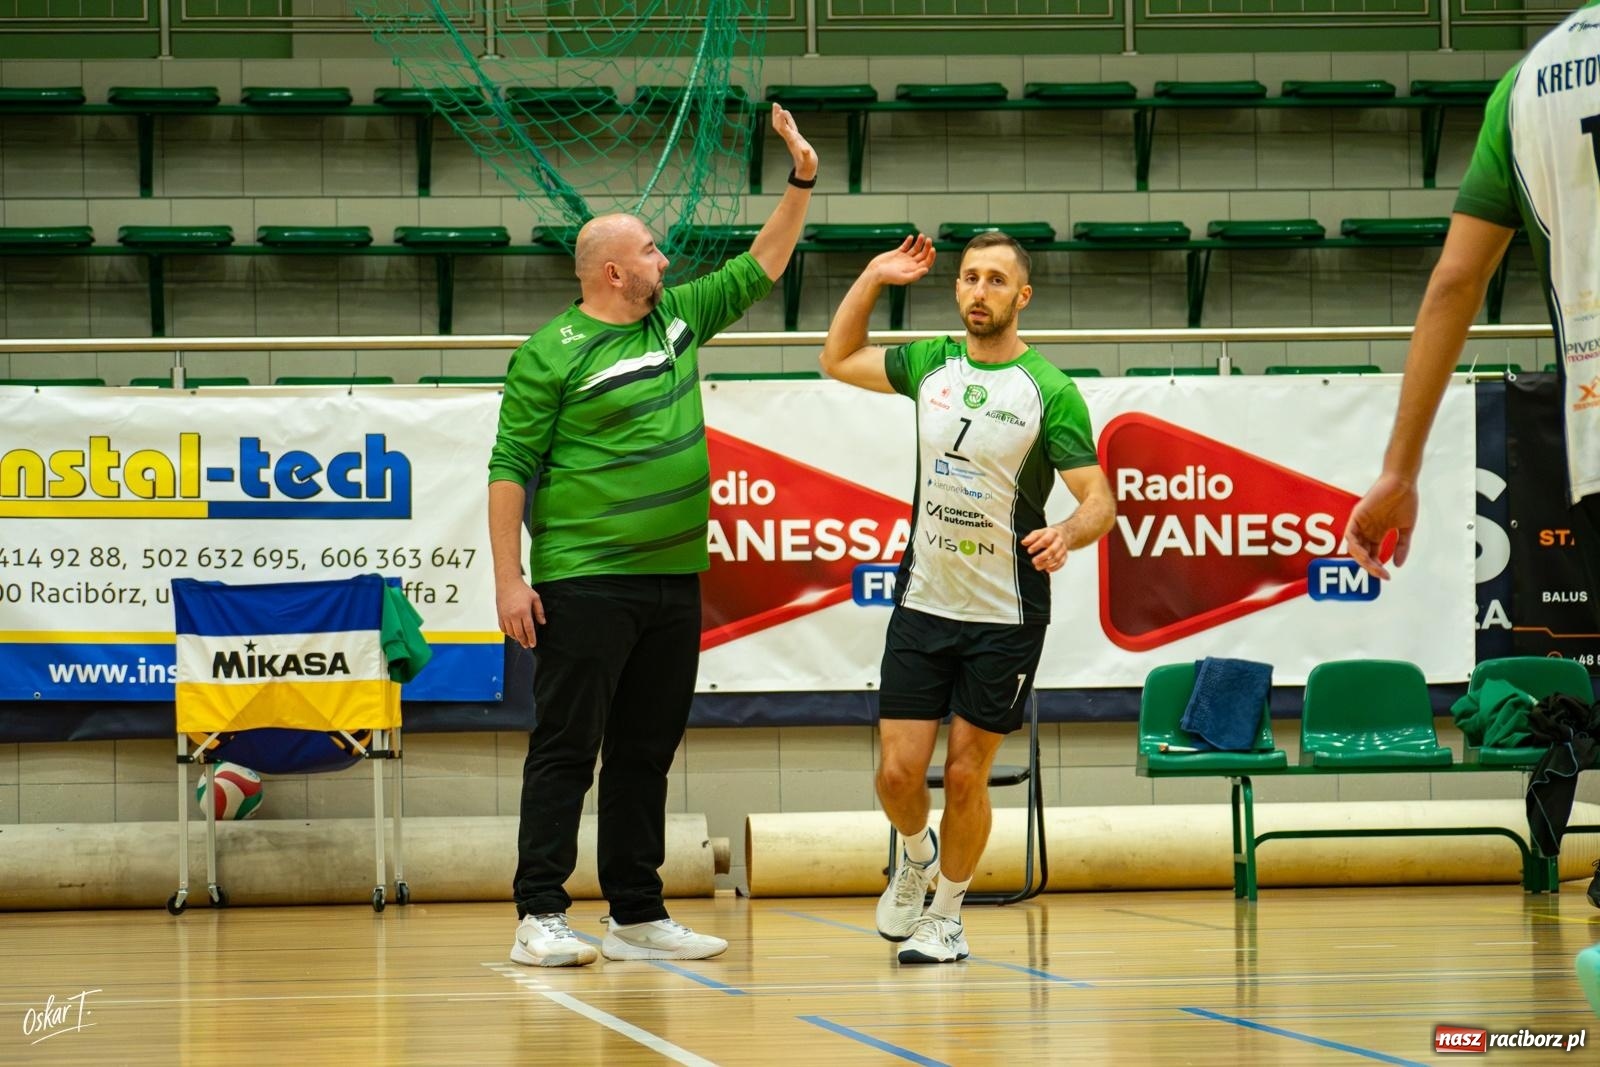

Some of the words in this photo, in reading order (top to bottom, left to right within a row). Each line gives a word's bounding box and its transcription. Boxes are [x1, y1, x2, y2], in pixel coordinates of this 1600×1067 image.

[952, 416, 973, 452] 7
[711, 470, 776, 506] dio
[1117, 465, 1234, 501] Radio
[944, 506, 985, 520] CONCEPT
[944, 516, 994, 529] automatic
[1116, 512, 1349, 557] VANESS
[50, 548, 81, 570] 92
[89, 547, 128, 571] 88,
[142, 547, 189, 570] 502
[197, 547, 244, 570] 632
[253, 547, 306, 571] 695,
[321, 546, 368, 569] 606
[376, 547, 422, 569] 363
[431, 547, 477, 569] 647
[0, 583, 22, 604] 0
[31, 581, 147, 607] Racibórz,
[446, 584, 459, 604] 2
[1319, 566, 1369, 595] FM
[1475, 599, 1513, 630] A
